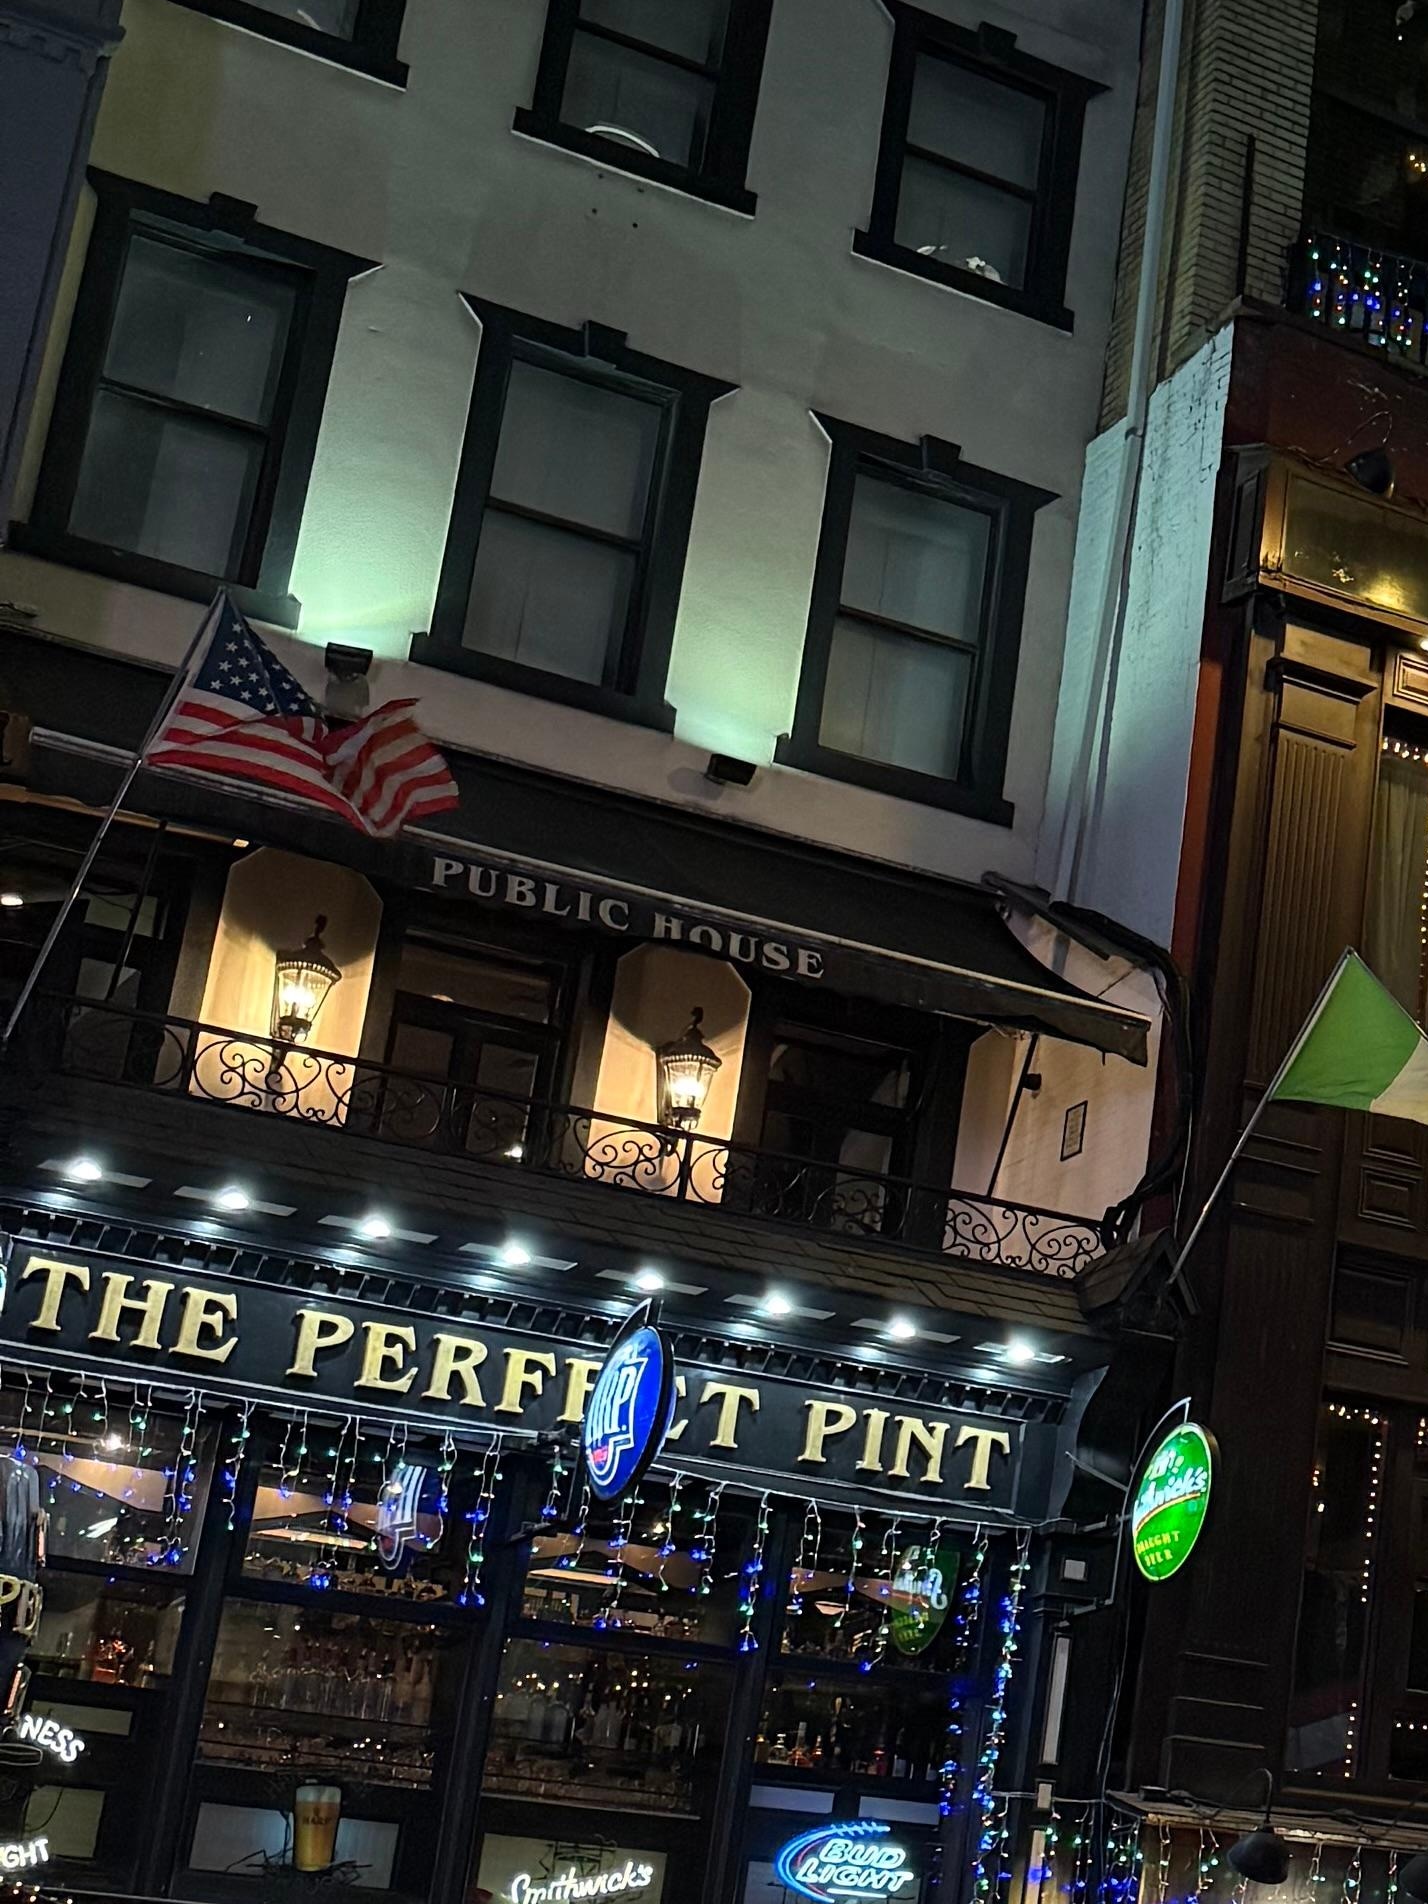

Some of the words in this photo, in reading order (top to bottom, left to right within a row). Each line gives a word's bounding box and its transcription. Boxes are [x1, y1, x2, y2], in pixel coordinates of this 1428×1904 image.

[431, 856, 630, 932] PUBLIC
[652, 912, 825, 979] HOUSE
[22, 1256, 238, 1363] THE
[797, 1400, 1010, 1490] PINT
[0, 1838, 49, 1868] GHT
[819, 1838, 906, 1869] BUD
[796, 1857, 914, 1892] LIGHT
